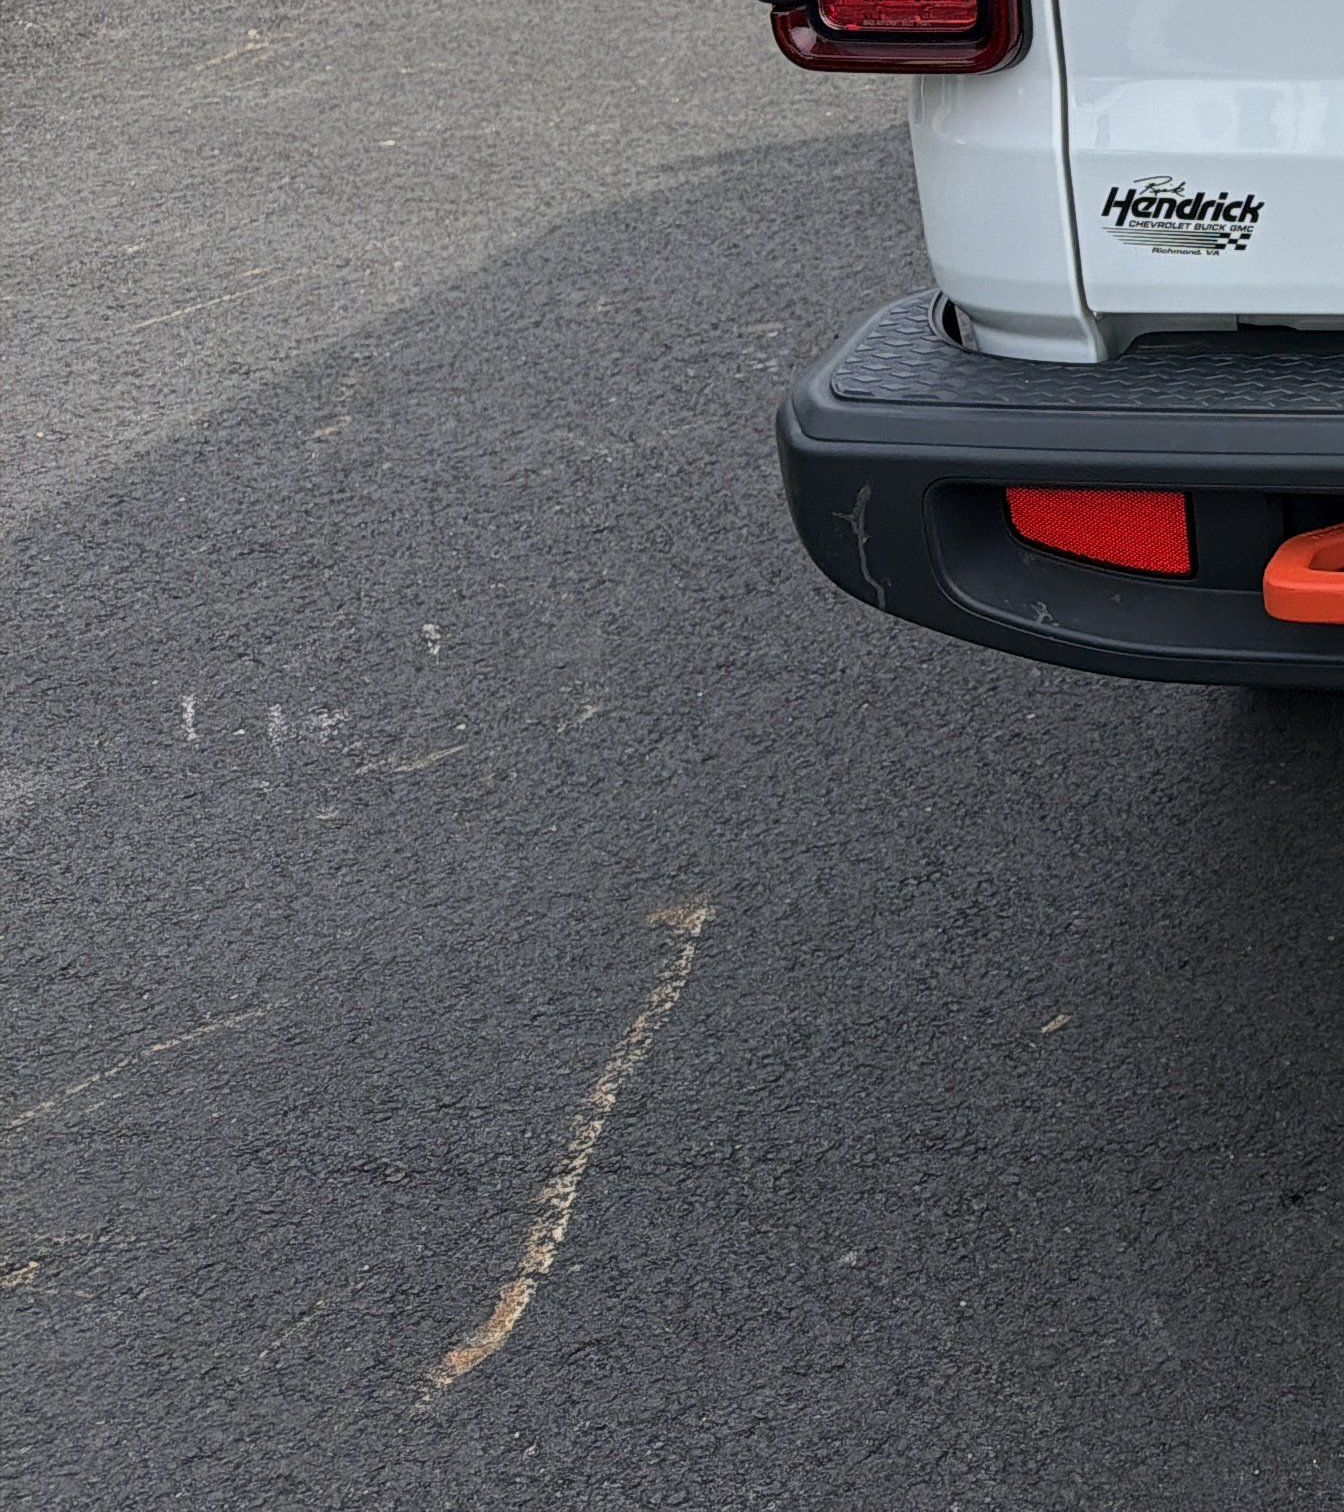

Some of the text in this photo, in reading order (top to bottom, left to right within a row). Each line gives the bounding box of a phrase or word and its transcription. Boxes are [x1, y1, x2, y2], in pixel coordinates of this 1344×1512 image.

[1101, 186, 1266, 227] Hendrick
[1128, 219, 1255, 233] CHEVROLET BUICK GMC
